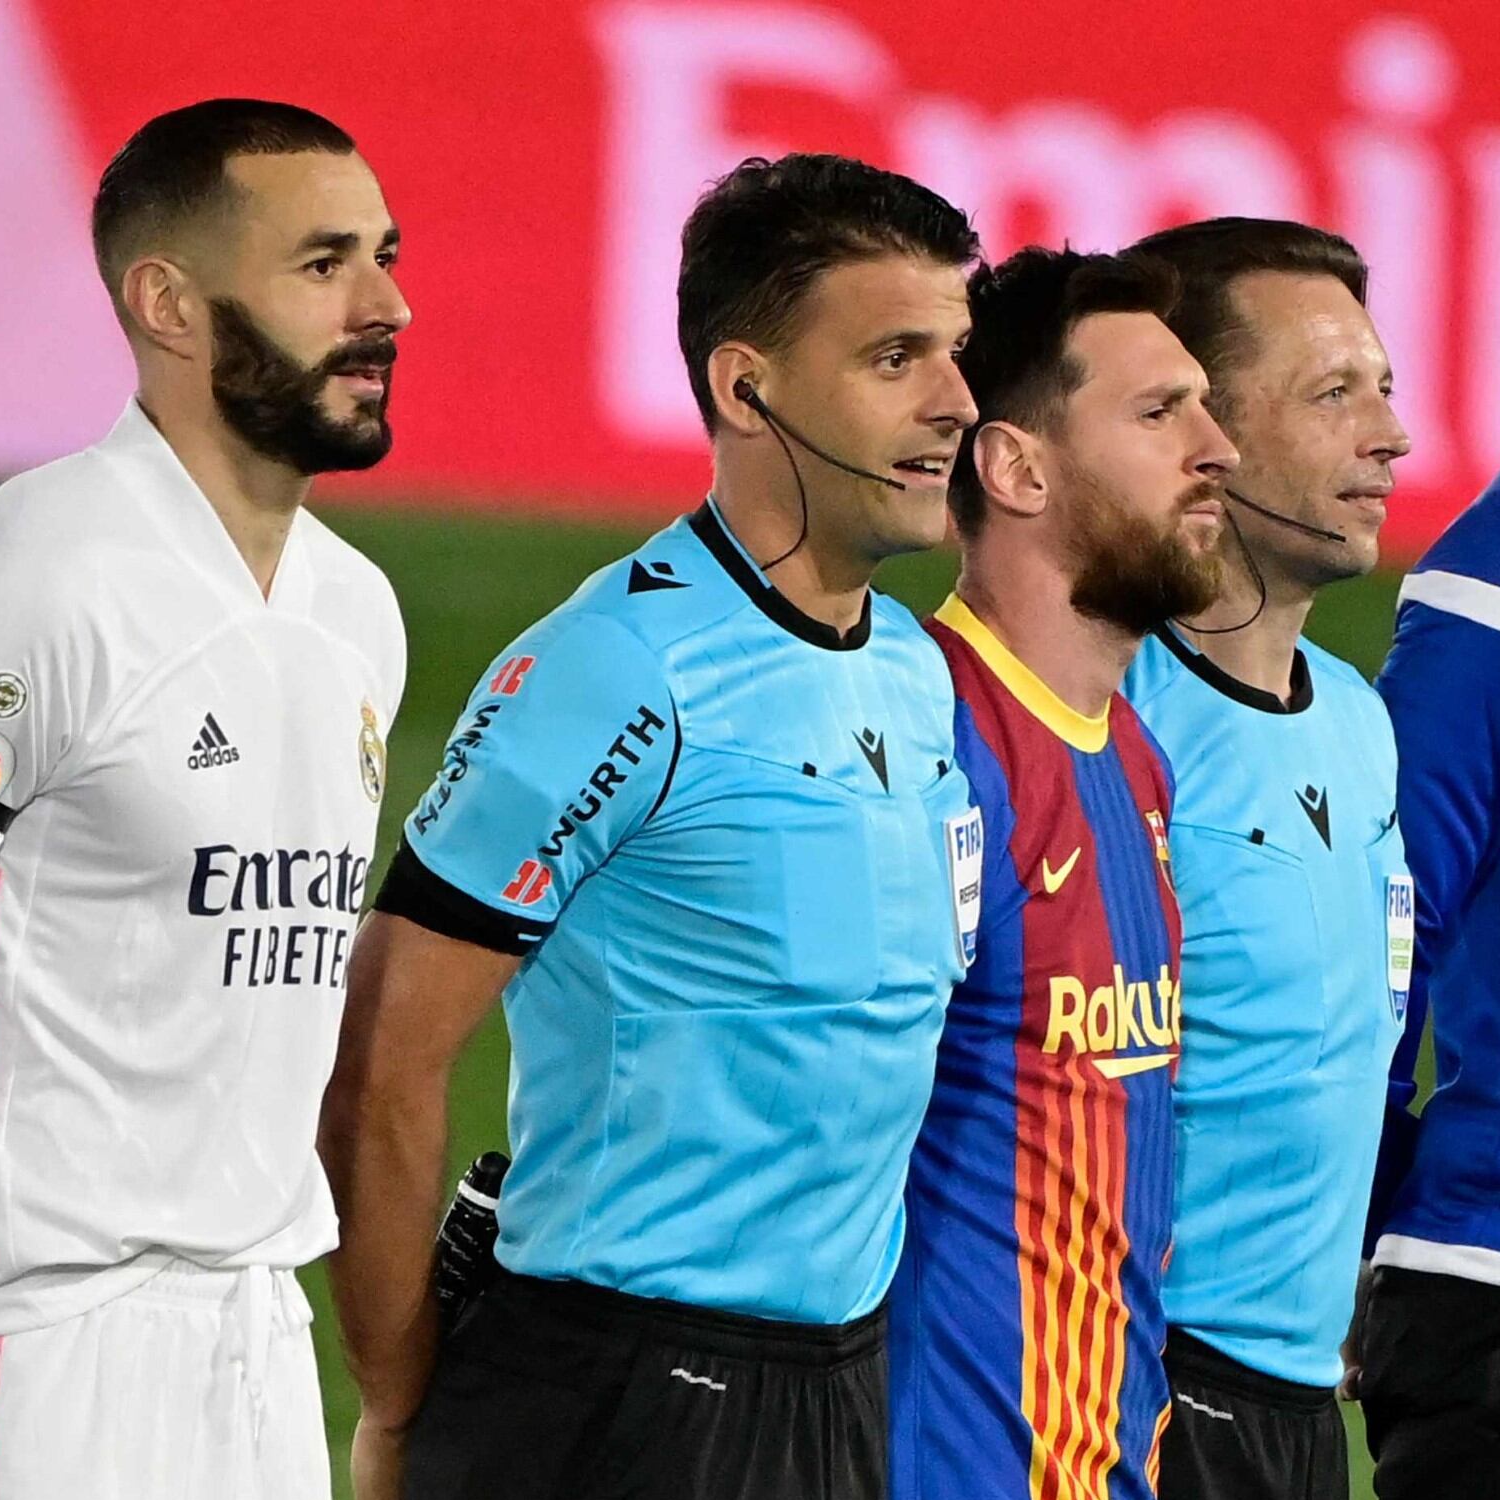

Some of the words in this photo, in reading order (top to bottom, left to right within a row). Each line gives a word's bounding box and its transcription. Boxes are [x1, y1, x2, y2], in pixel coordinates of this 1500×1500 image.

[187, 745, 240, 770] adidas
[538, 704, 667, 857] WÜRTH
[1388, 884, 1412, 919] FIFA
